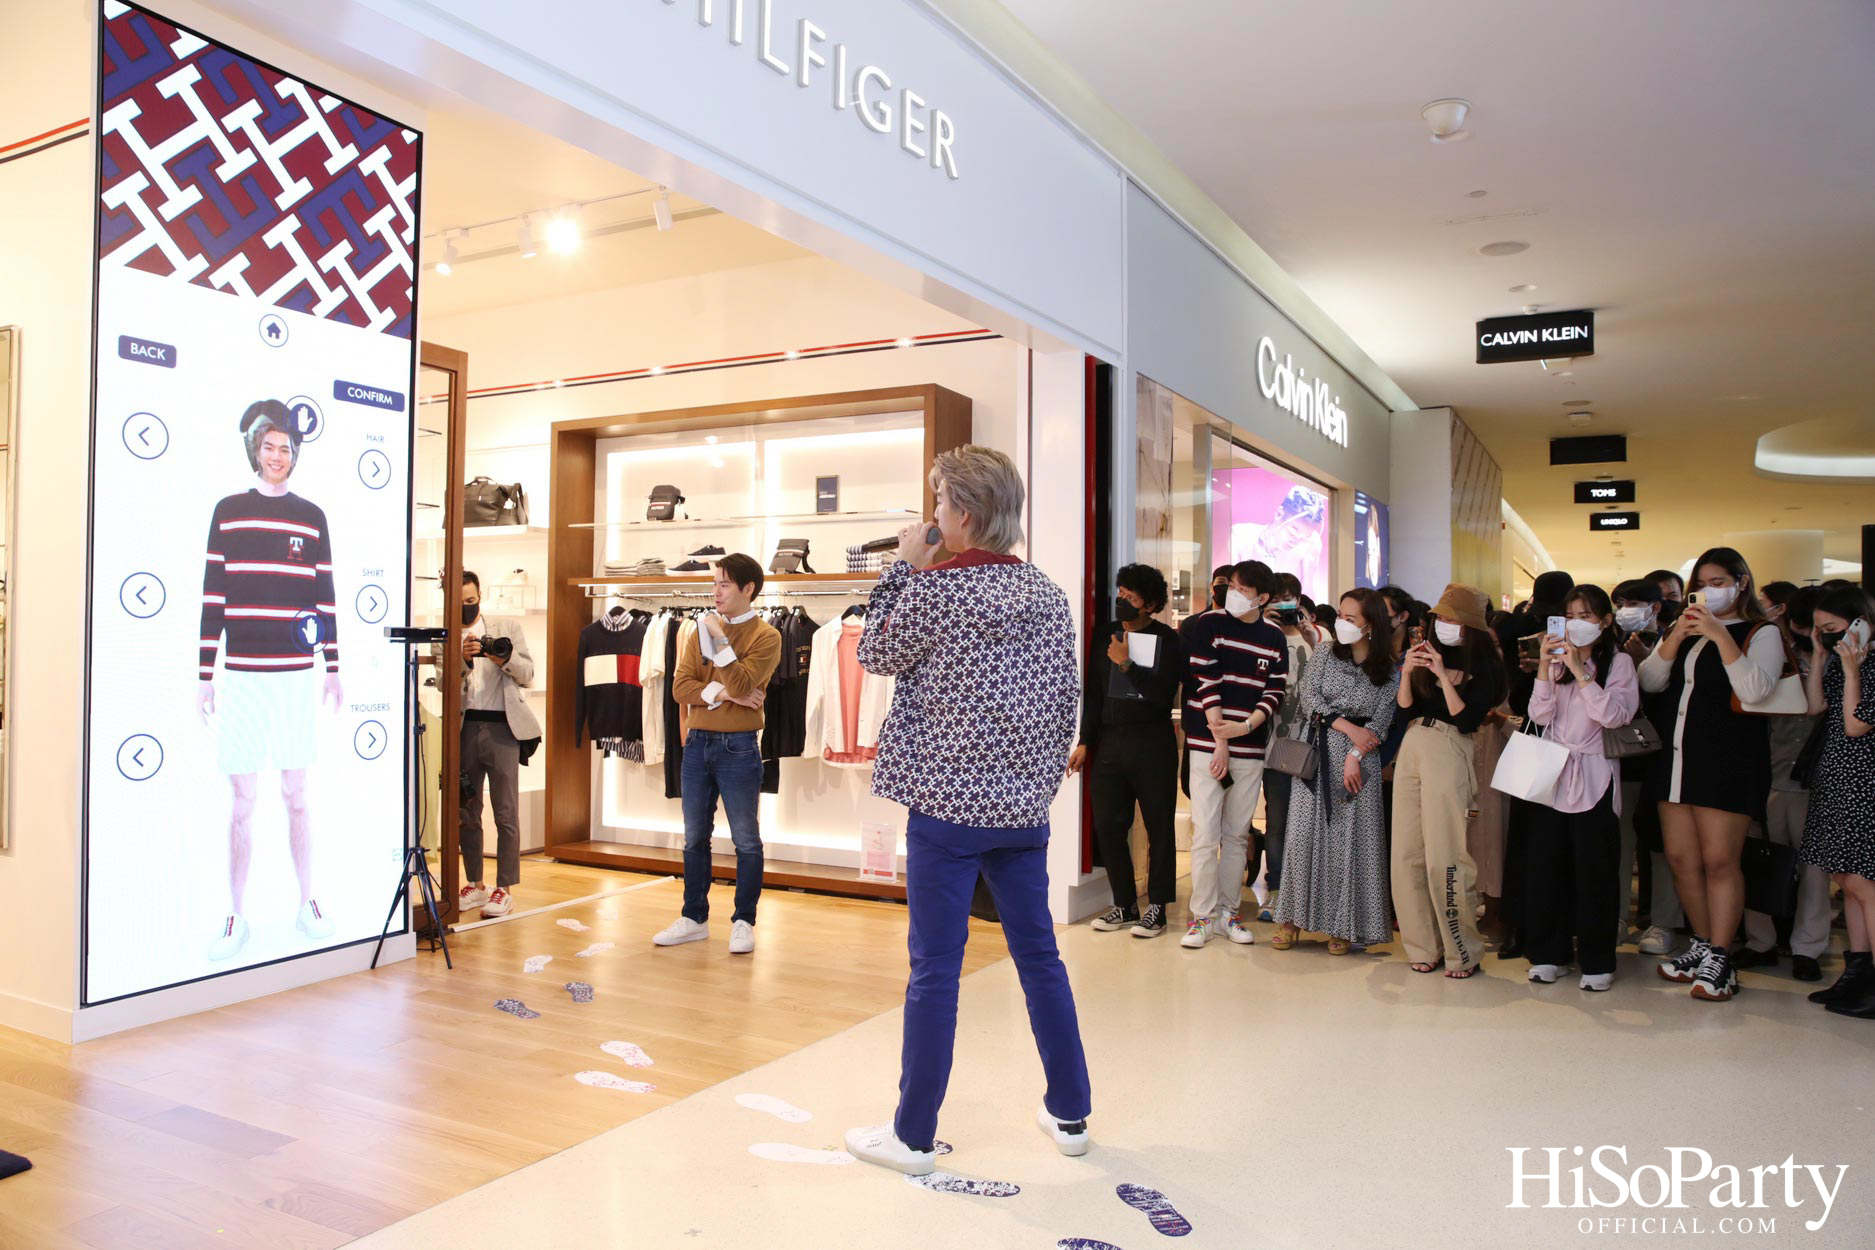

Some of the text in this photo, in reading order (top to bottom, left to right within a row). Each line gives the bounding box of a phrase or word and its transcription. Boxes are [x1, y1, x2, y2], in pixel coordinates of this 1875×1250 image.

[661, 0, 959, 180] ILFIGER
[1480, 325, 1588, 347] CALVIN KLEIN
[130, 341, 167, 361] BACK
[347, 386, 393, 405] CONFIRM
[1257, 336, 1348, 449] Calvin Klein
[366, 433, 385, 444] HAIR
[1590, 488, 1616, 497] TOMS
[362, 568, 385, 578] SHIRT
[350, 702, 391, 713] TROUSERS
